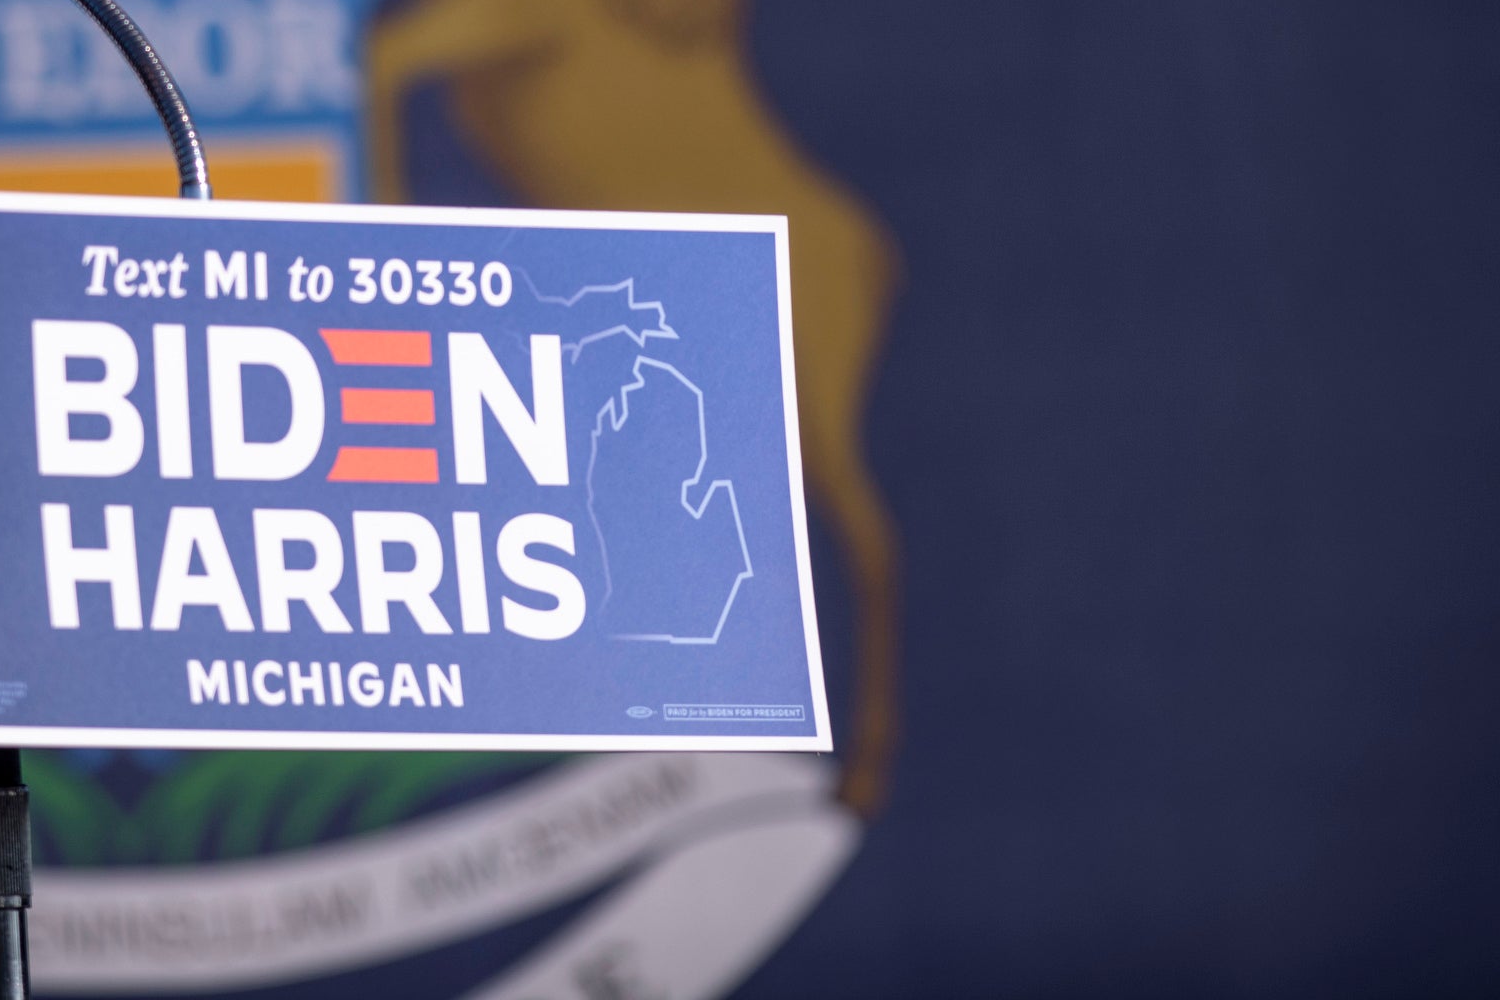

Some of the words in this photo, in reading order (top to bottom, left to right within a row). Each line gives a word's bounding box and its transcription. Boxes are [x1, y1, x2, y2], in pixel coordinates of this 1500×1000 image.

[81, 244, 190, 299] Text
[203, 249, 269, 301] MI
[287, 255, 335, 303] to
[348, 257, 513, 308] 30330
[31, 318, 570, 487] BIDEN
[40, 502, 587, 642] HARRIS
[186, 658, 465, 708] MICHIGAN
[666, 708, 688, 717] PAID
[707, 708, 734, 717] BIDEN
[734, 708, 753, 717] FOR
[753, 708, 801, 717] PRESIDENT
